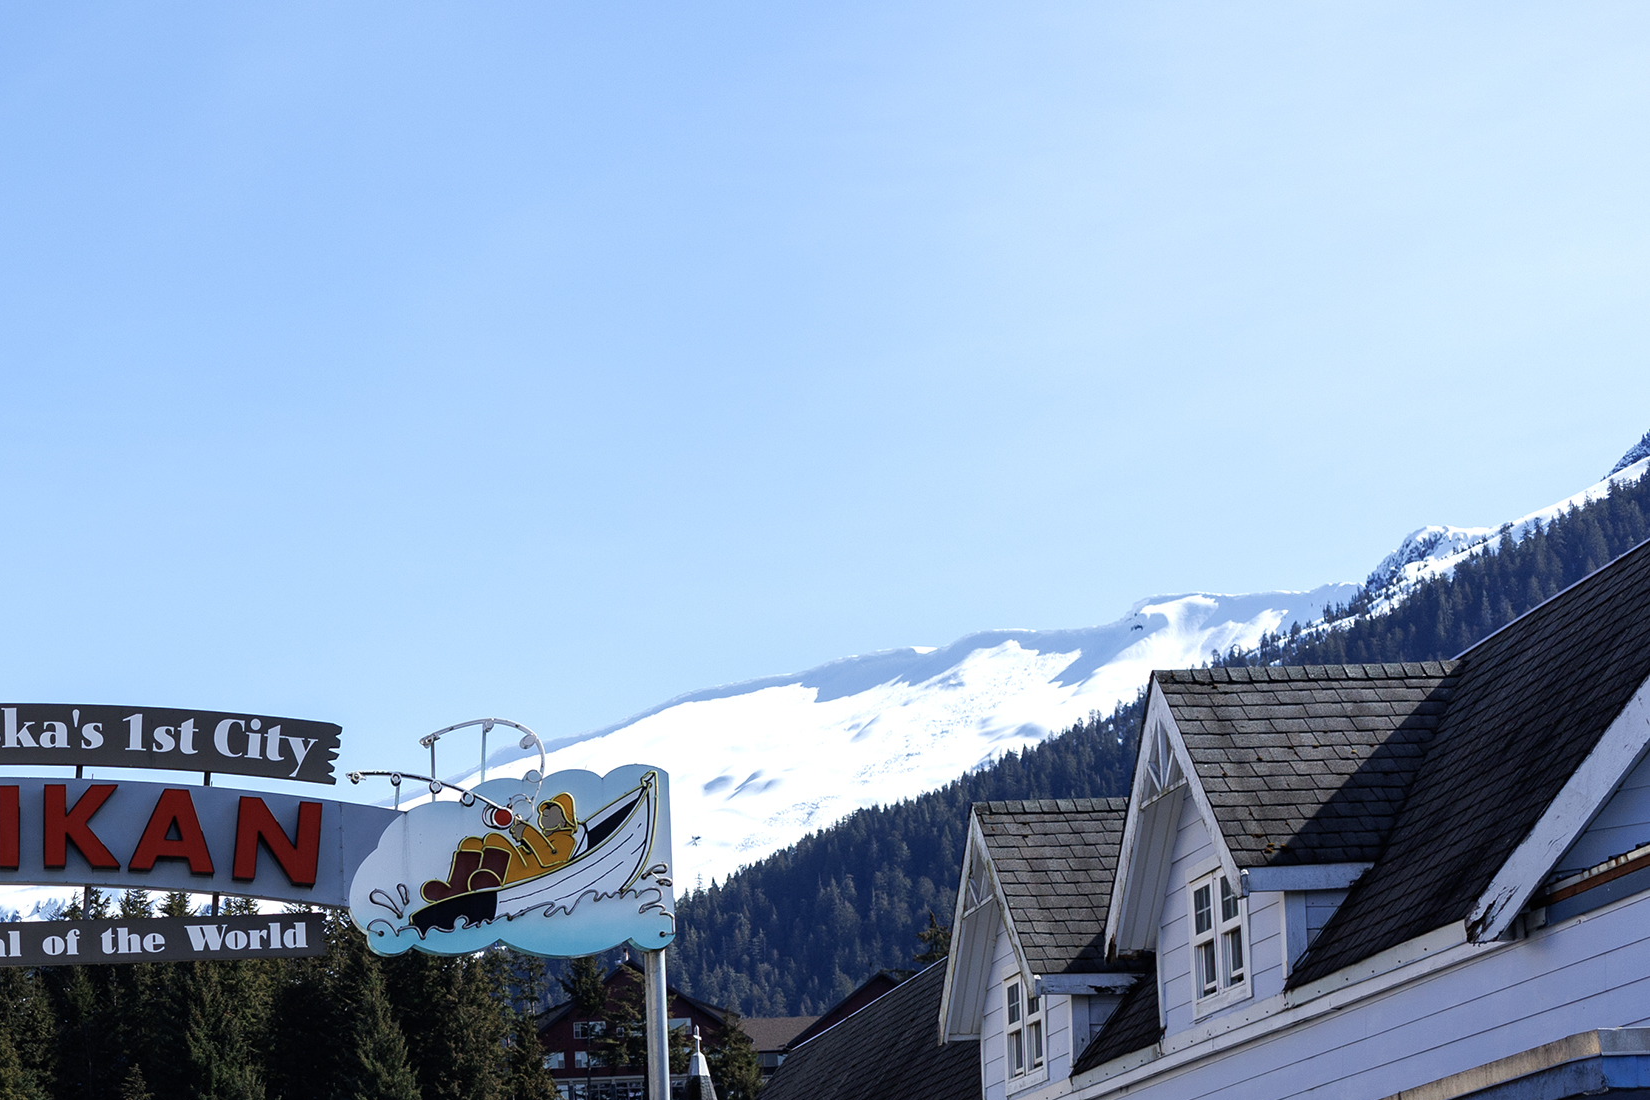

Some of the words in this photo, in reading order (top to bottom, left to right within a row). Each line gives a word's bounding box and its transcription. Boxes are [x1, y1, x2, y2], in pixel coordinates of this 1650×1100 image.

[123, 713, 199, 755] 1st
[213, 718, 318, 777] City
[43, 929, 81, 957] of
[101, 927, 166, 954] the
[184, 922, 308, 951] World
